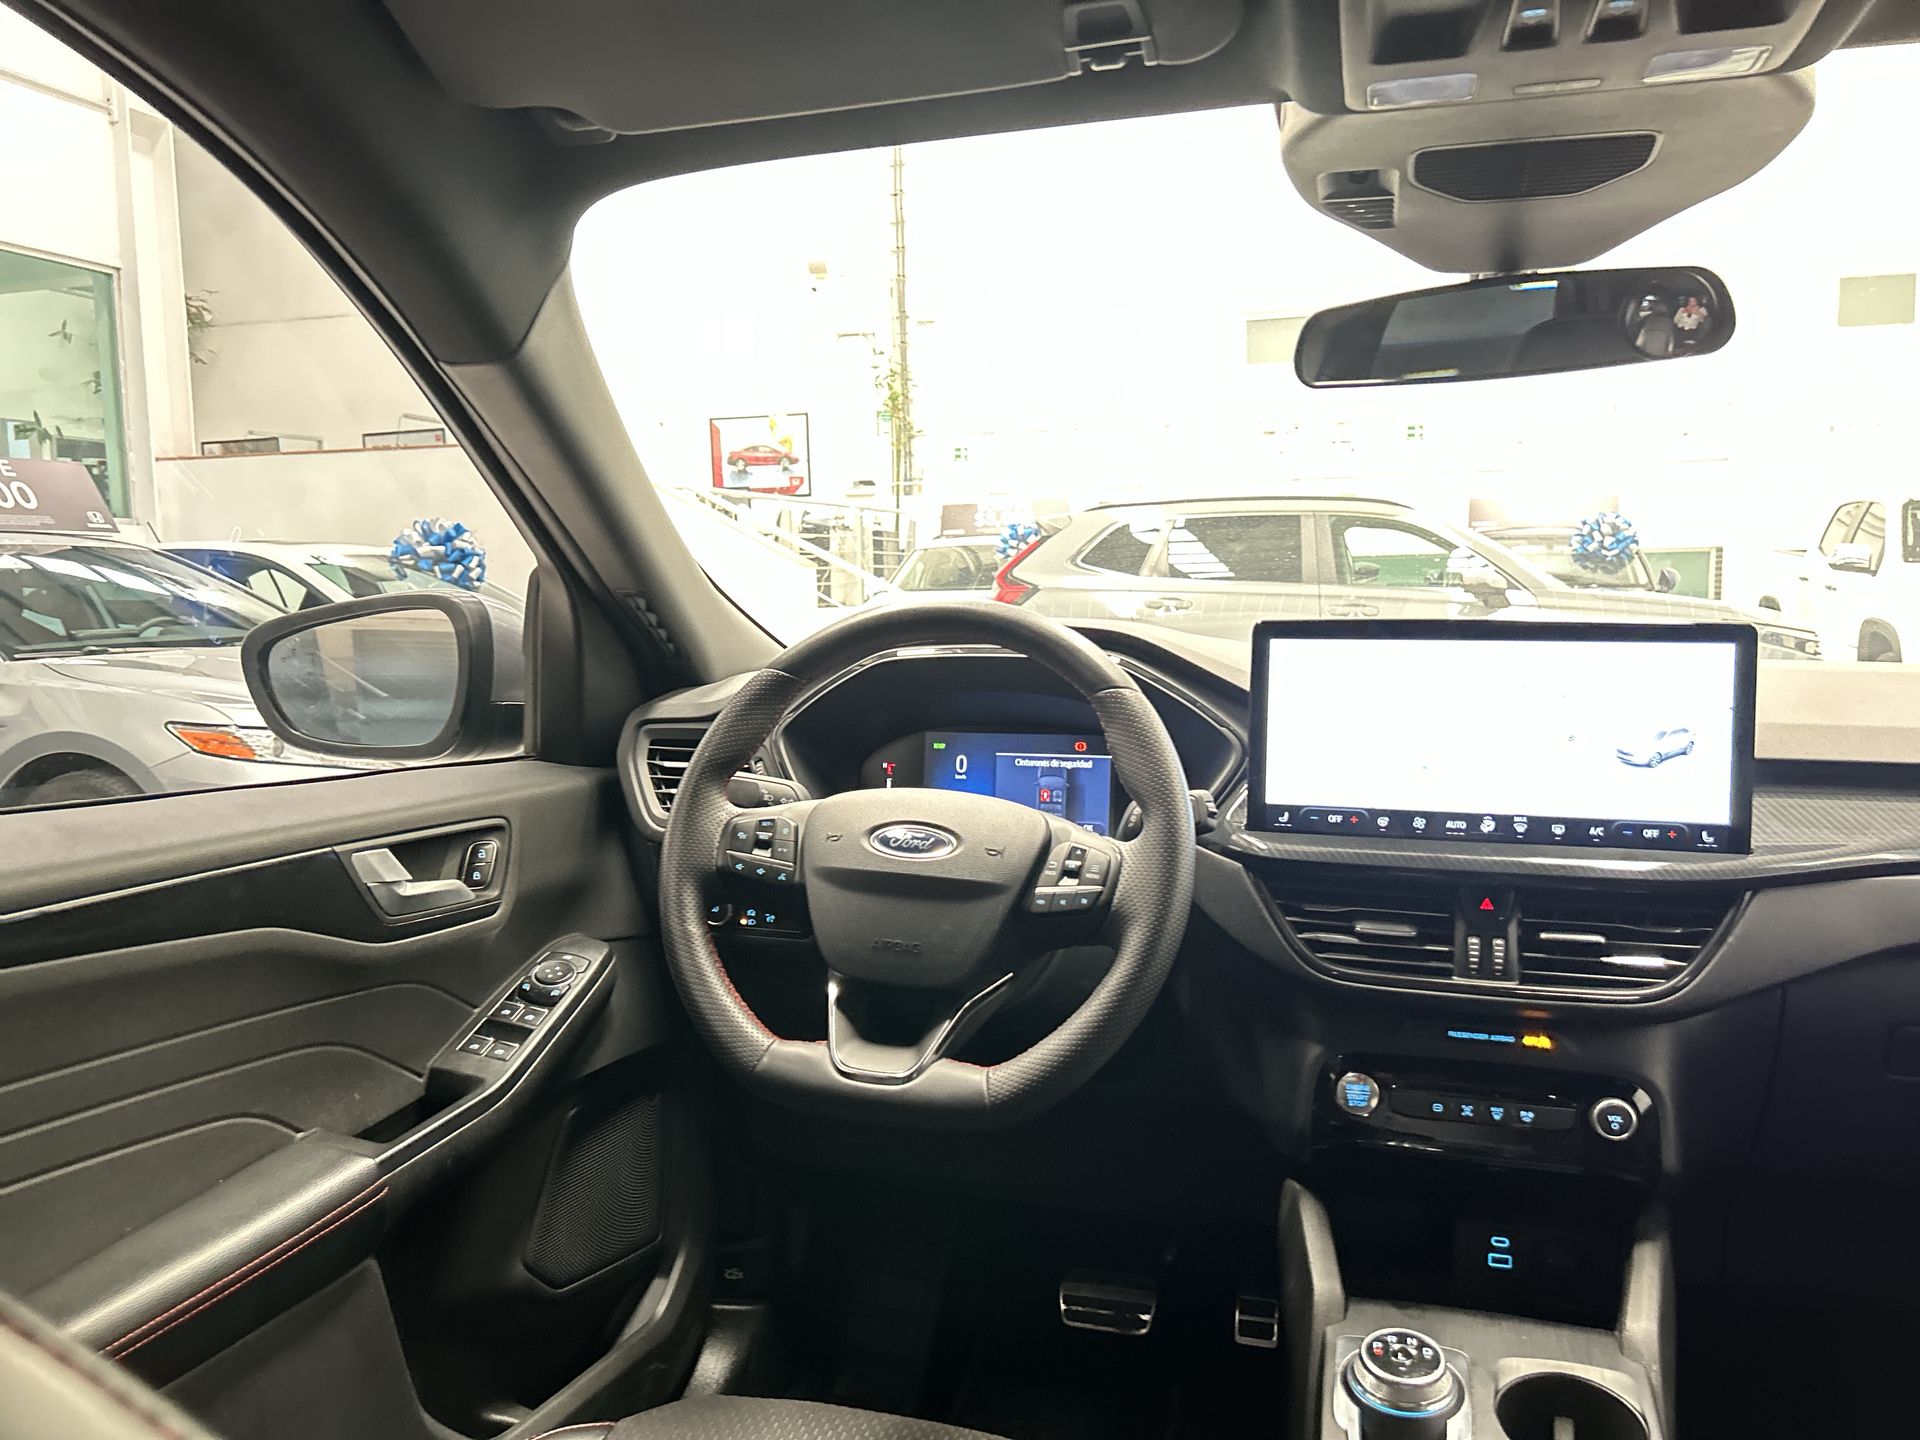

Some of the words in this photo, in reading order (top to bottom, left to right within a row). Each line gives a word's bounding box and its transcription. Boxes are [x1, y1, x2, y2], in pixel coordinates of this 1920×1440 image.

[955, 754, 968, 774] 0
[1014, 758, 1050, 767] Cinturones
[1050, 759, 1059, 768] de
[1060, 759, 1093, 769] seguridad
[1327, 815, 1343, 823] OFF
[1445, 820, 1467, 830] AUTO
[1588, 826, 1604, 837] A/C
[1642, 829, 1660, 838] OFF
[889, 831, 935, 850] Ford
[1406, 1337, 1417, 1346] N
